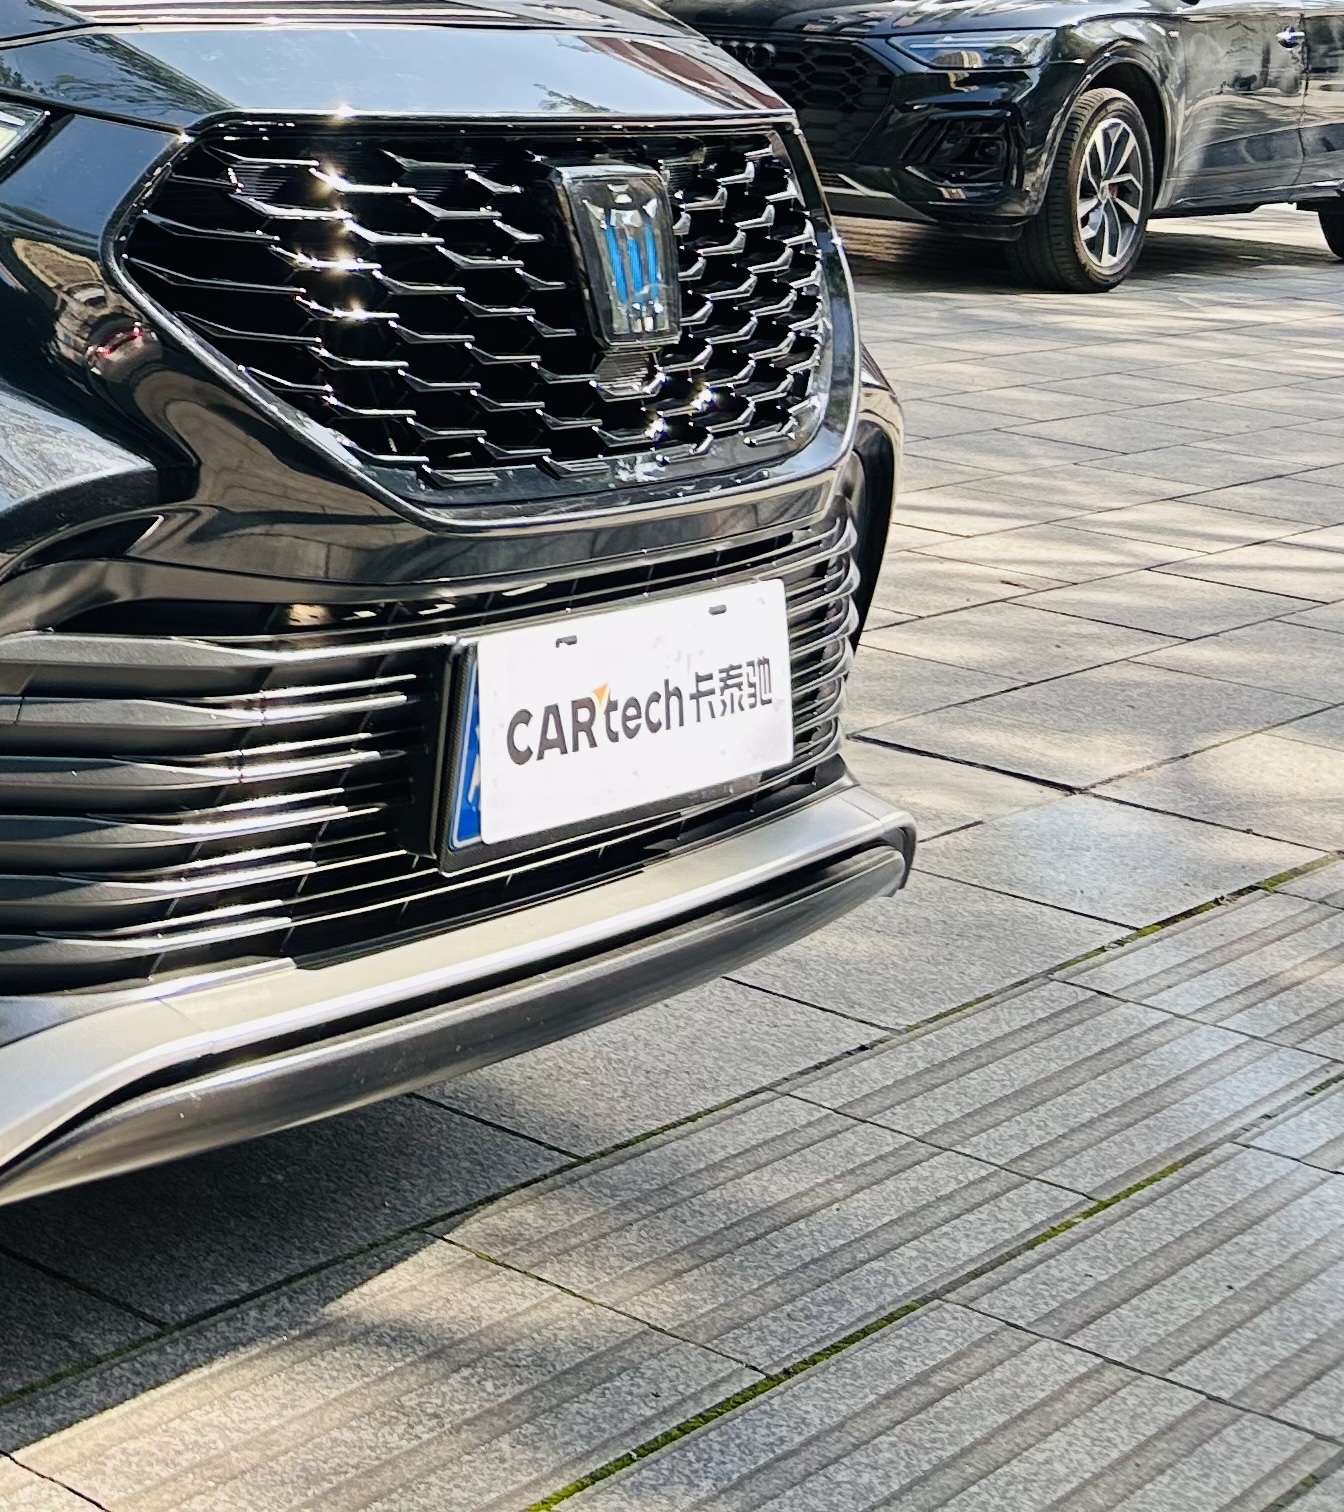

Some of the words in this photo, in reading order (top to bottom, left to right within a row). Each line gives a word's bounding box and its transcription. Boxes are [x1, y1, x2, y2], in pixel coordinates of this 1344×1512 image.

[506, 679, 685, 766] CARtech
[689, 655, 773, 722] 卡泰驰
